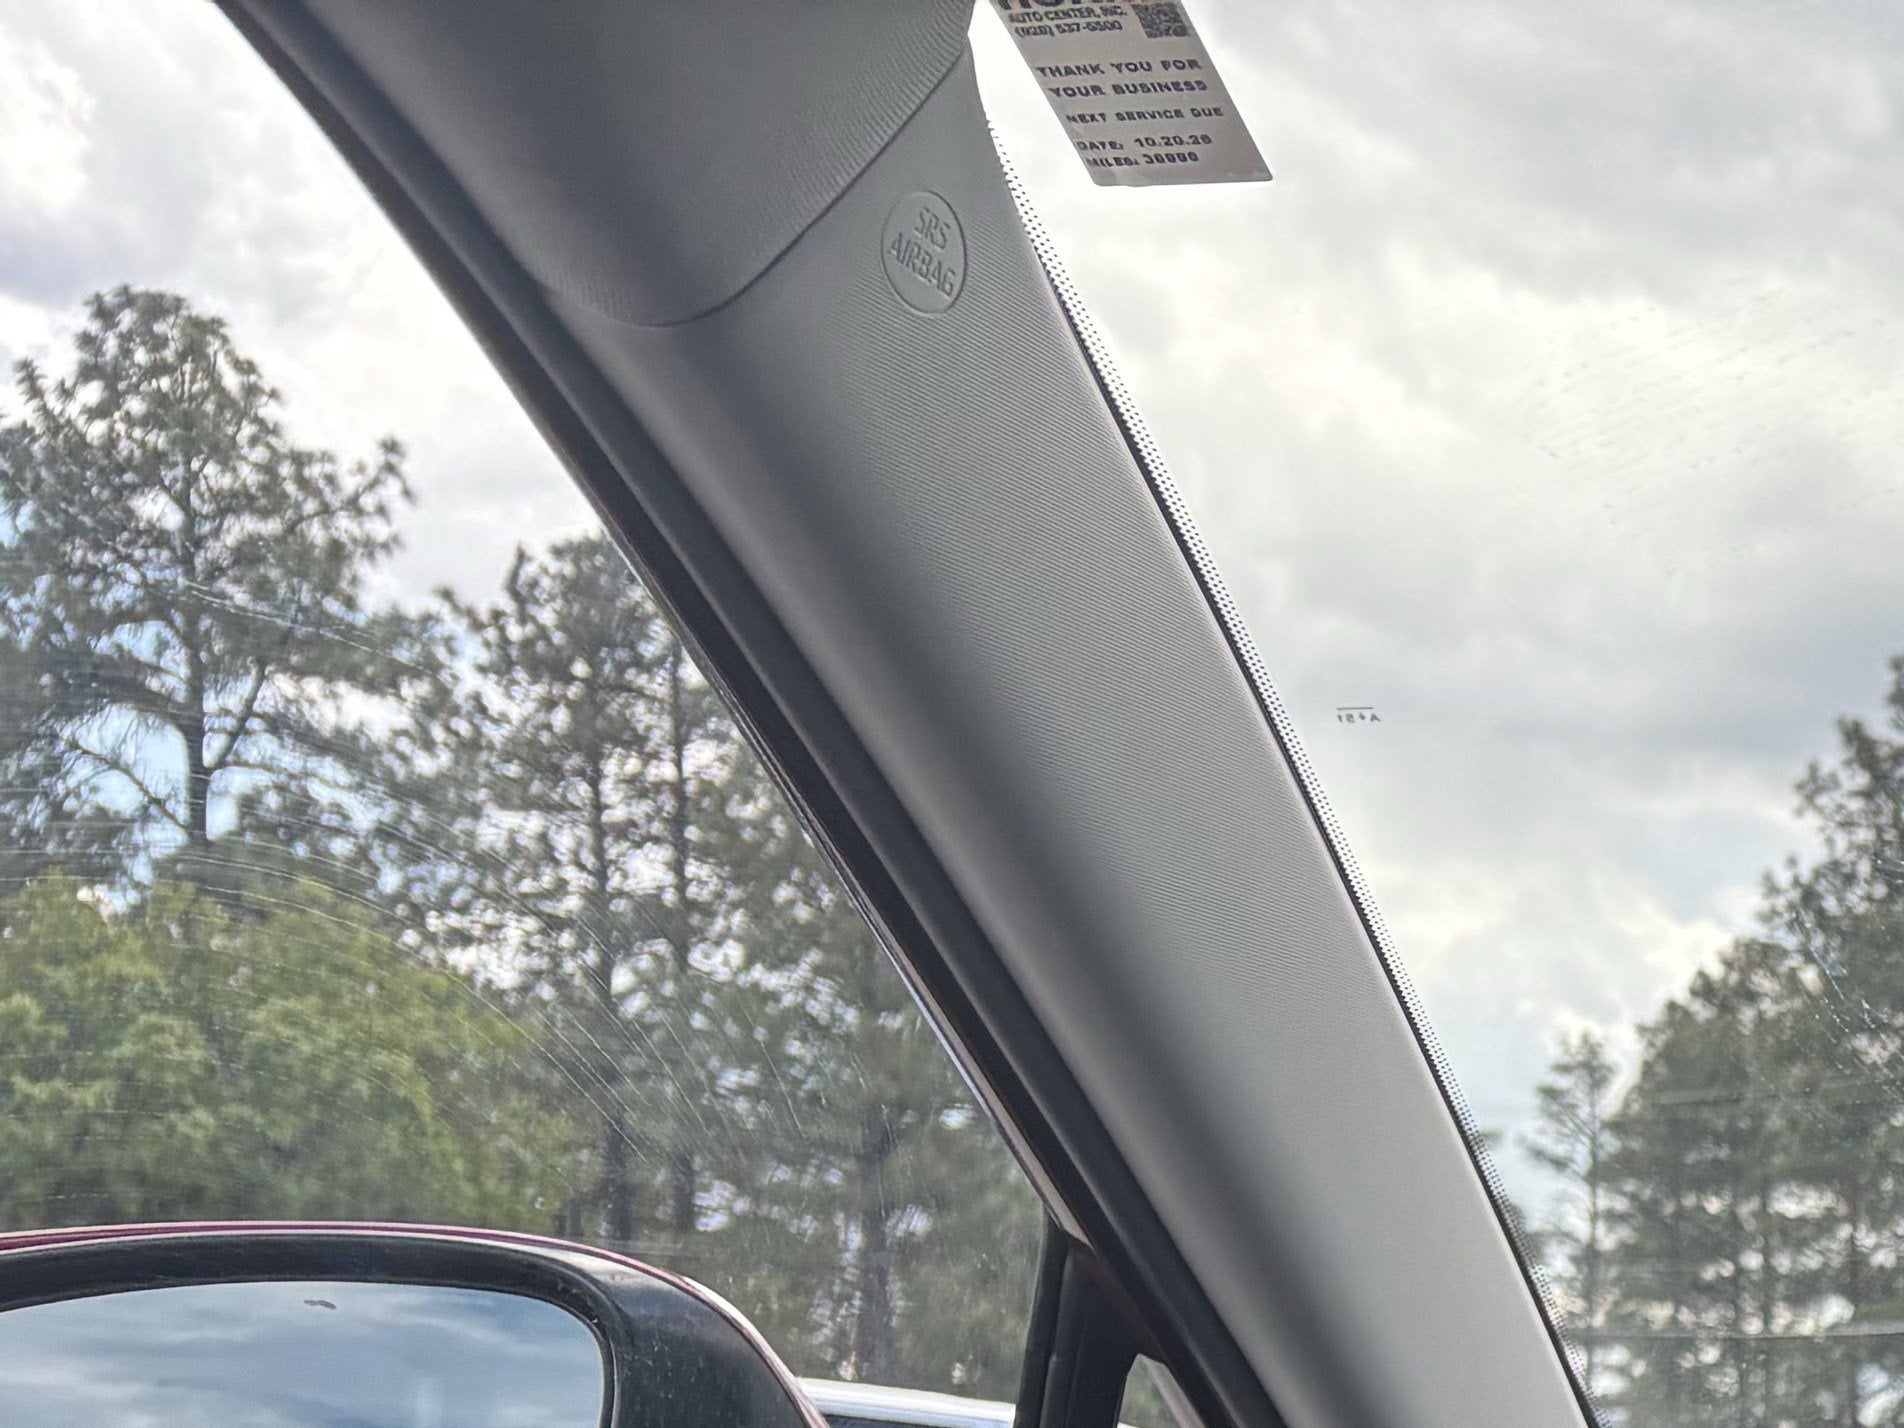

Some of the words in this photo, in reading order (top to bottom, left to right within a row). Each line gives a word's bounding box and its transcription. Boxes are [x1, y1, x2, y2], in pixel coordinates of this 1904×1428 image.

[1008, 11, 1042, 23] AUTO
[1036, 63, 1105, 78] THANK
[1110, 61, 1153, 74] YOU
[1161, 59, 1203, 71] FOR
[1049, 84, 1105, 98] YOUR
[1113, 80, 1208, 95] BUSINESS
[1066, 112, 1107, 124] NEXT
[1116, 108, 1185, 121] SERVICE
[1190, 107, 1225, 118] DUE
[1076, 138, 1124, 150] DATE:
[915, 207, 950, 250] SRS
[887, 232, 956, 298] AIRBAG
